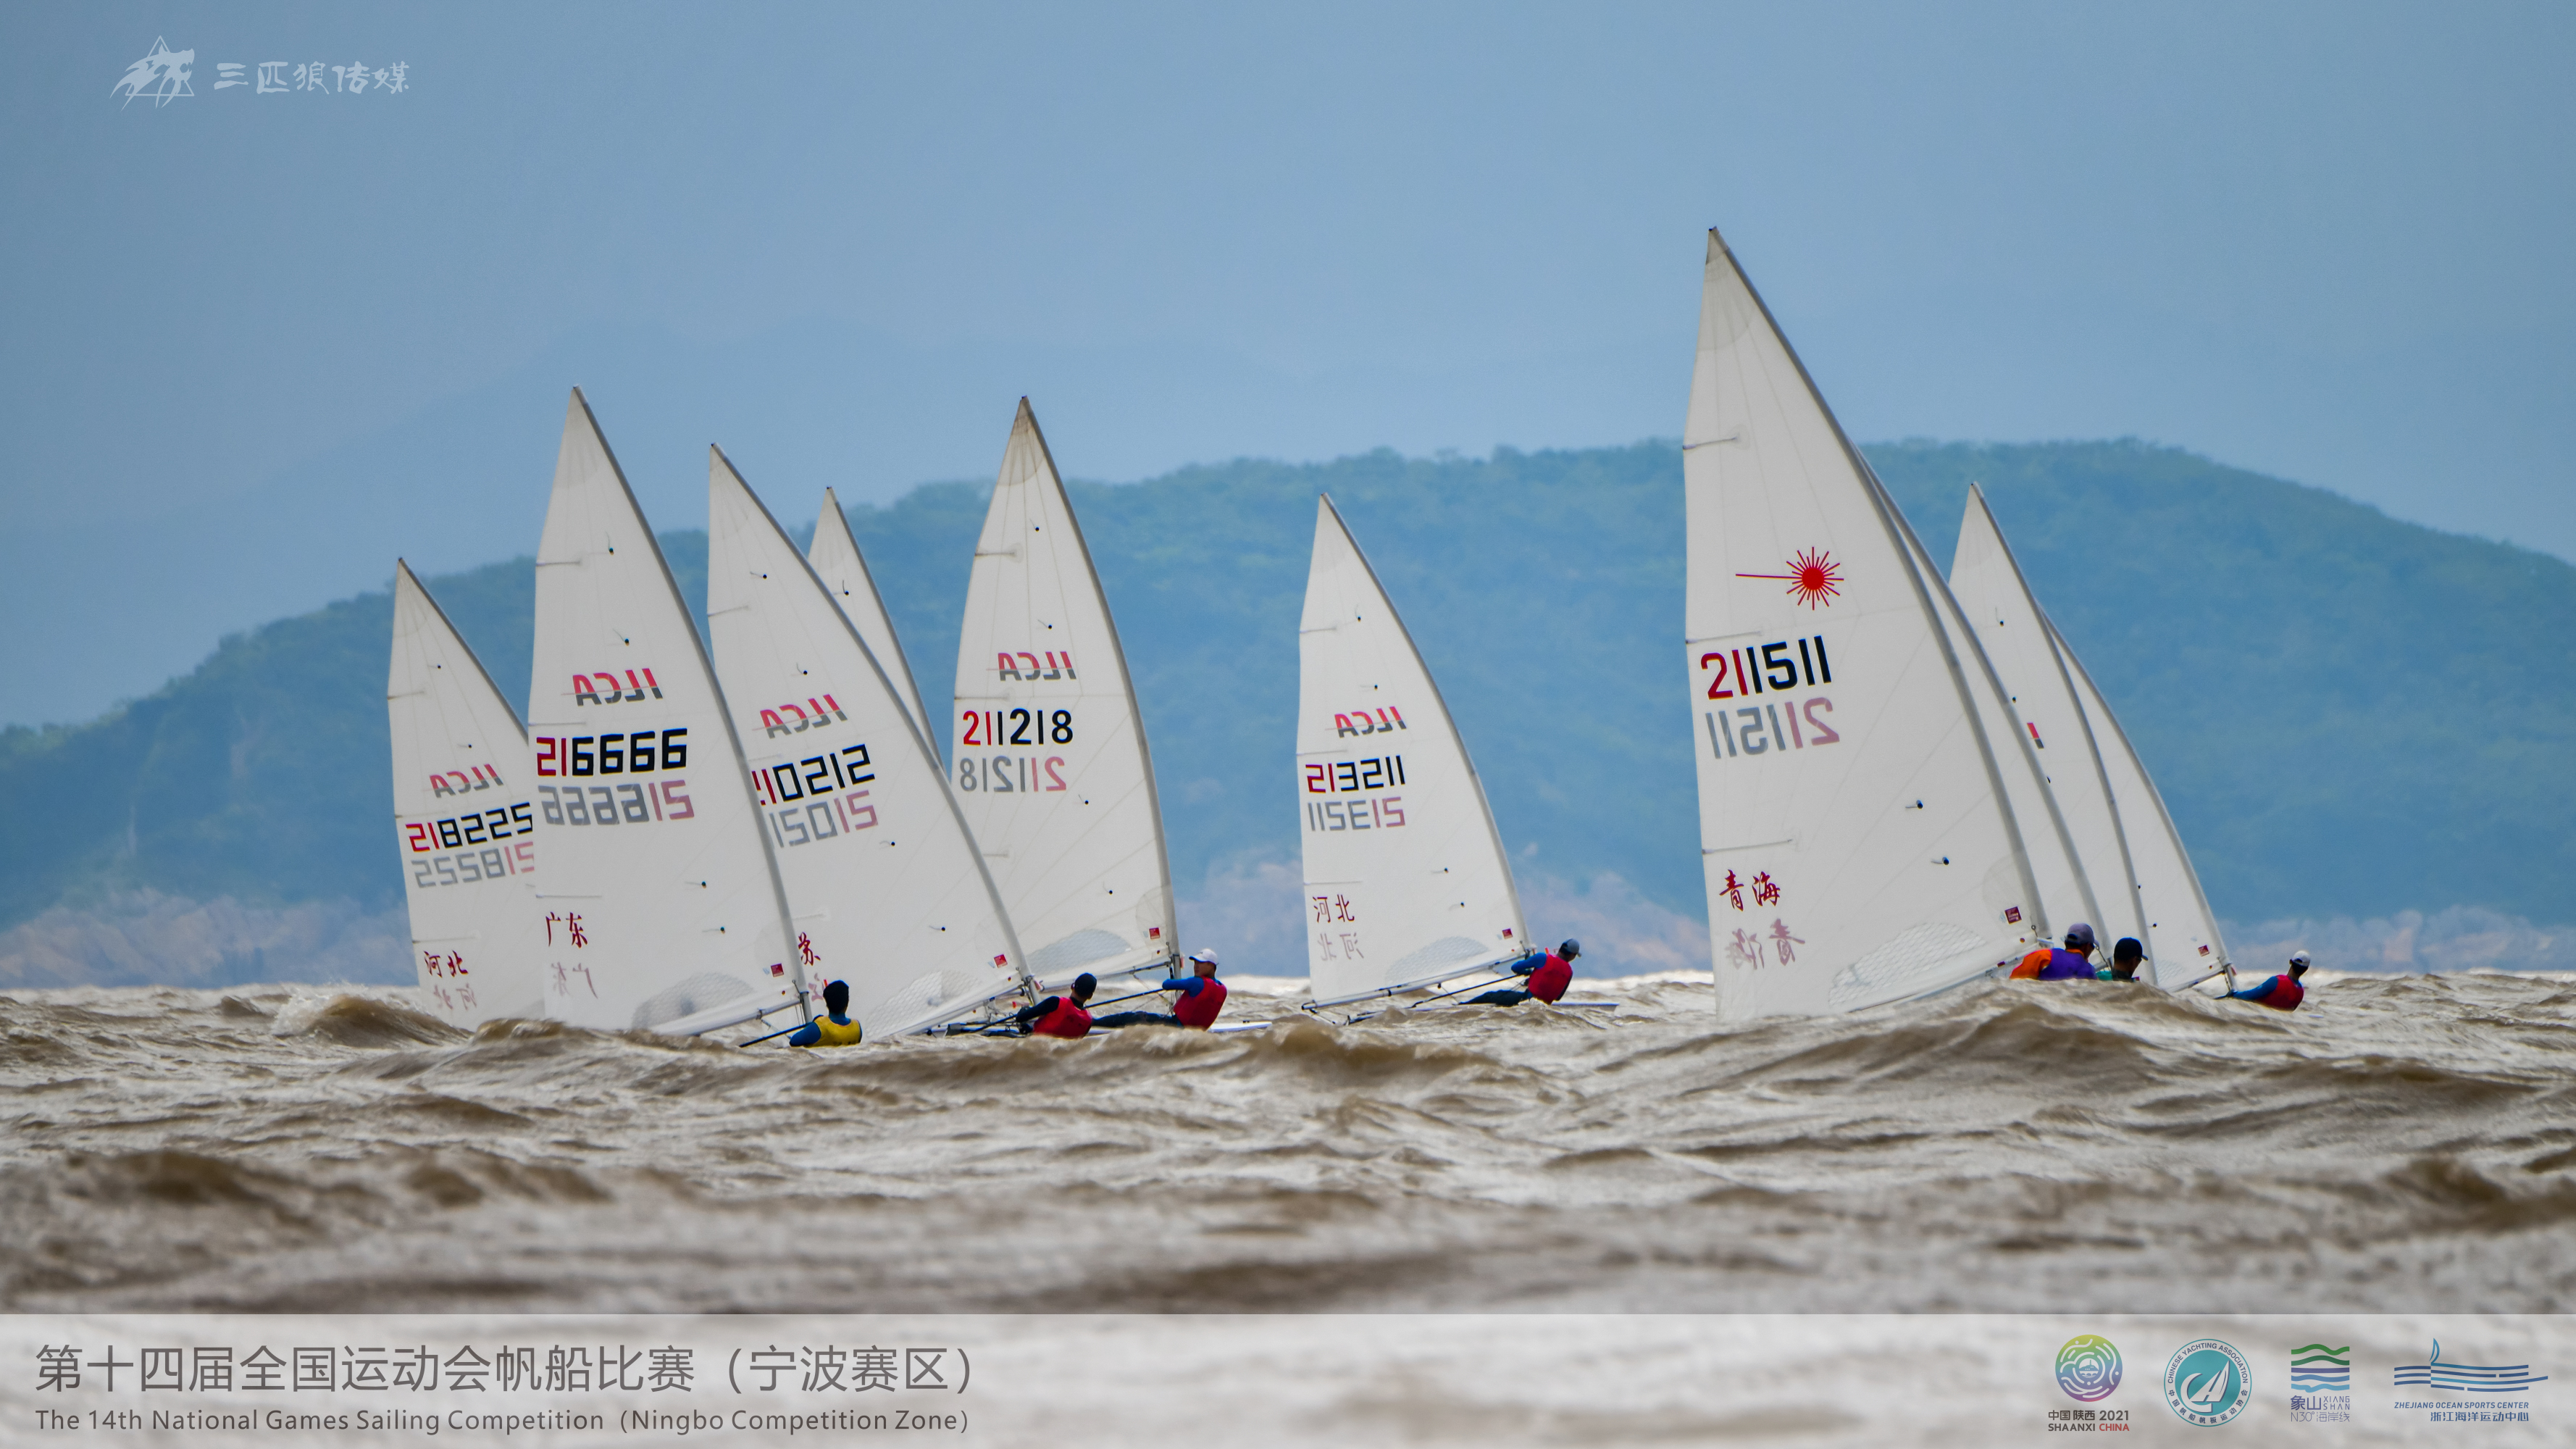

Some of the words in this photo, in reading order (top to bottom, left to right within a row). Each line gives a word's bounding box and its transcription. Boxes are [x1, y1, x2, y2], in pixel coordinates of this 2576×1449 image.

[1700, 635, 1832, 700] 211511
[963, 707, 1074, 746] 211218
[536, 728, 687, 777] 216666
[1305, 754, 1405, 793] 213211
[405, 801, 533, 853] 218225
[1312, 894, 1355, 923] 河北
[1719, 869, 1781, 911] 青海
[545, 911, 588, 948] 广东
[424, 950, 469, 978] 河北
